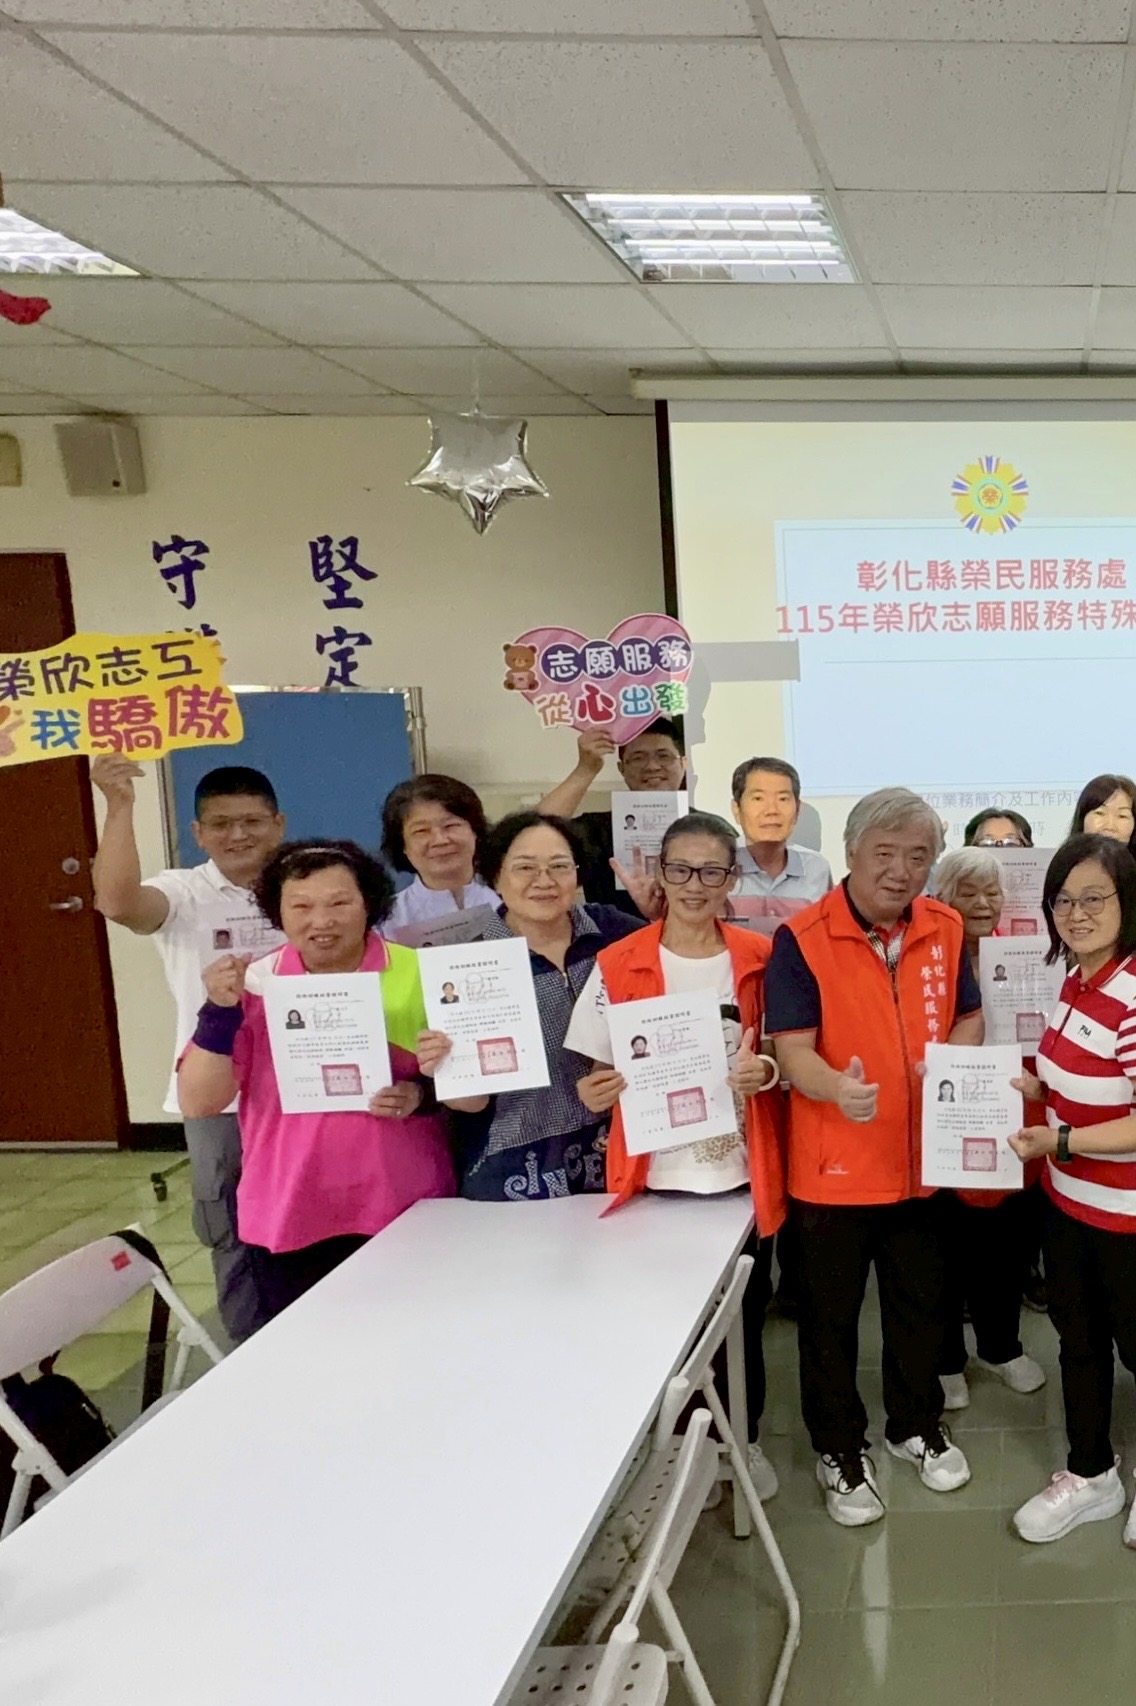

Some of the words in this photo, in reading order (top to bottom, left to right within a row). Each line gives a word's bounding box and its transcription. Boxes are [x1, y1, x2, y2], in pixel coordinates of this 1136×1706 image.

[152, 535, 217, 636] 守
[856, 558, 1127, 592] 彰化縣榮民服務處
[309, 534, 378, 686] 堅定
[547, 639, 687, 678] 志願服務
[31, 684, 233, 752] 我驕傲
[535, 684, 685, 726] 從心出發
